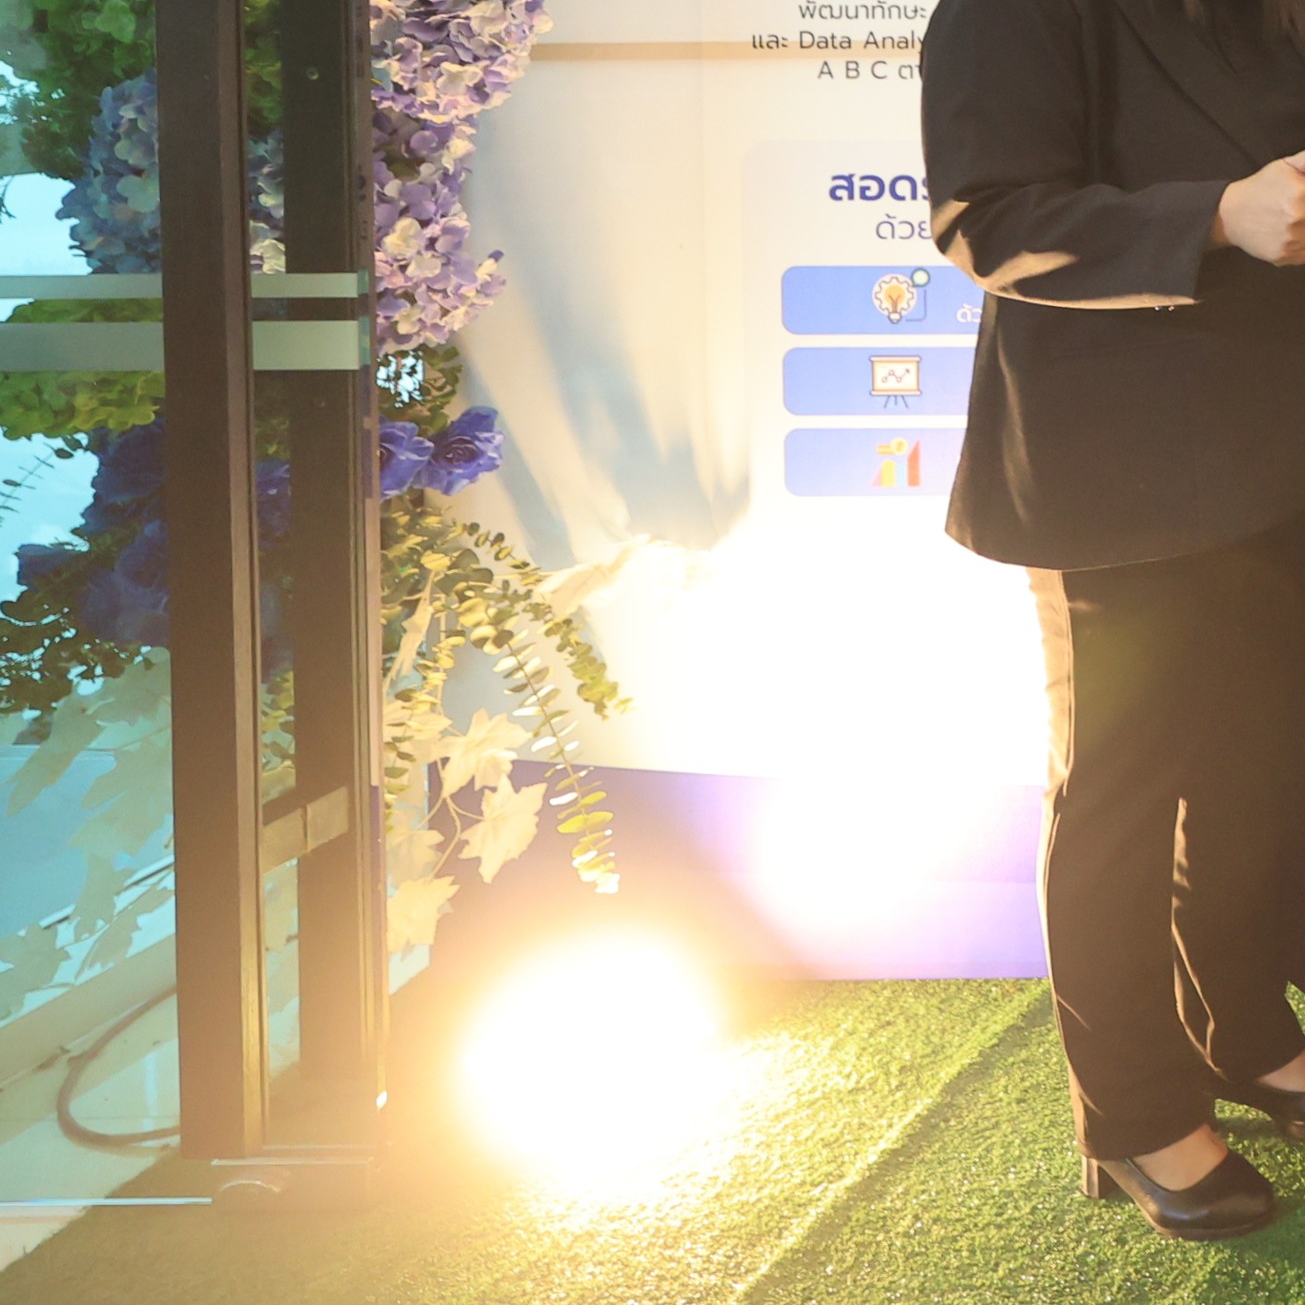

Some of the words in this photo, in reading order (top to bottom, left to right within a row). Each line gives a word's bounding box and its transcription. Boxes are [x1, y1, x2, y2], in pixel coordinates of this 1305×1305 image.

[752, 34, 789, 50] และ
[799, 31, 852, 50] Data
[817, 60, 834, 80] A
[845, 60, 860, 80] B
[870, 60, 887, 80] C
